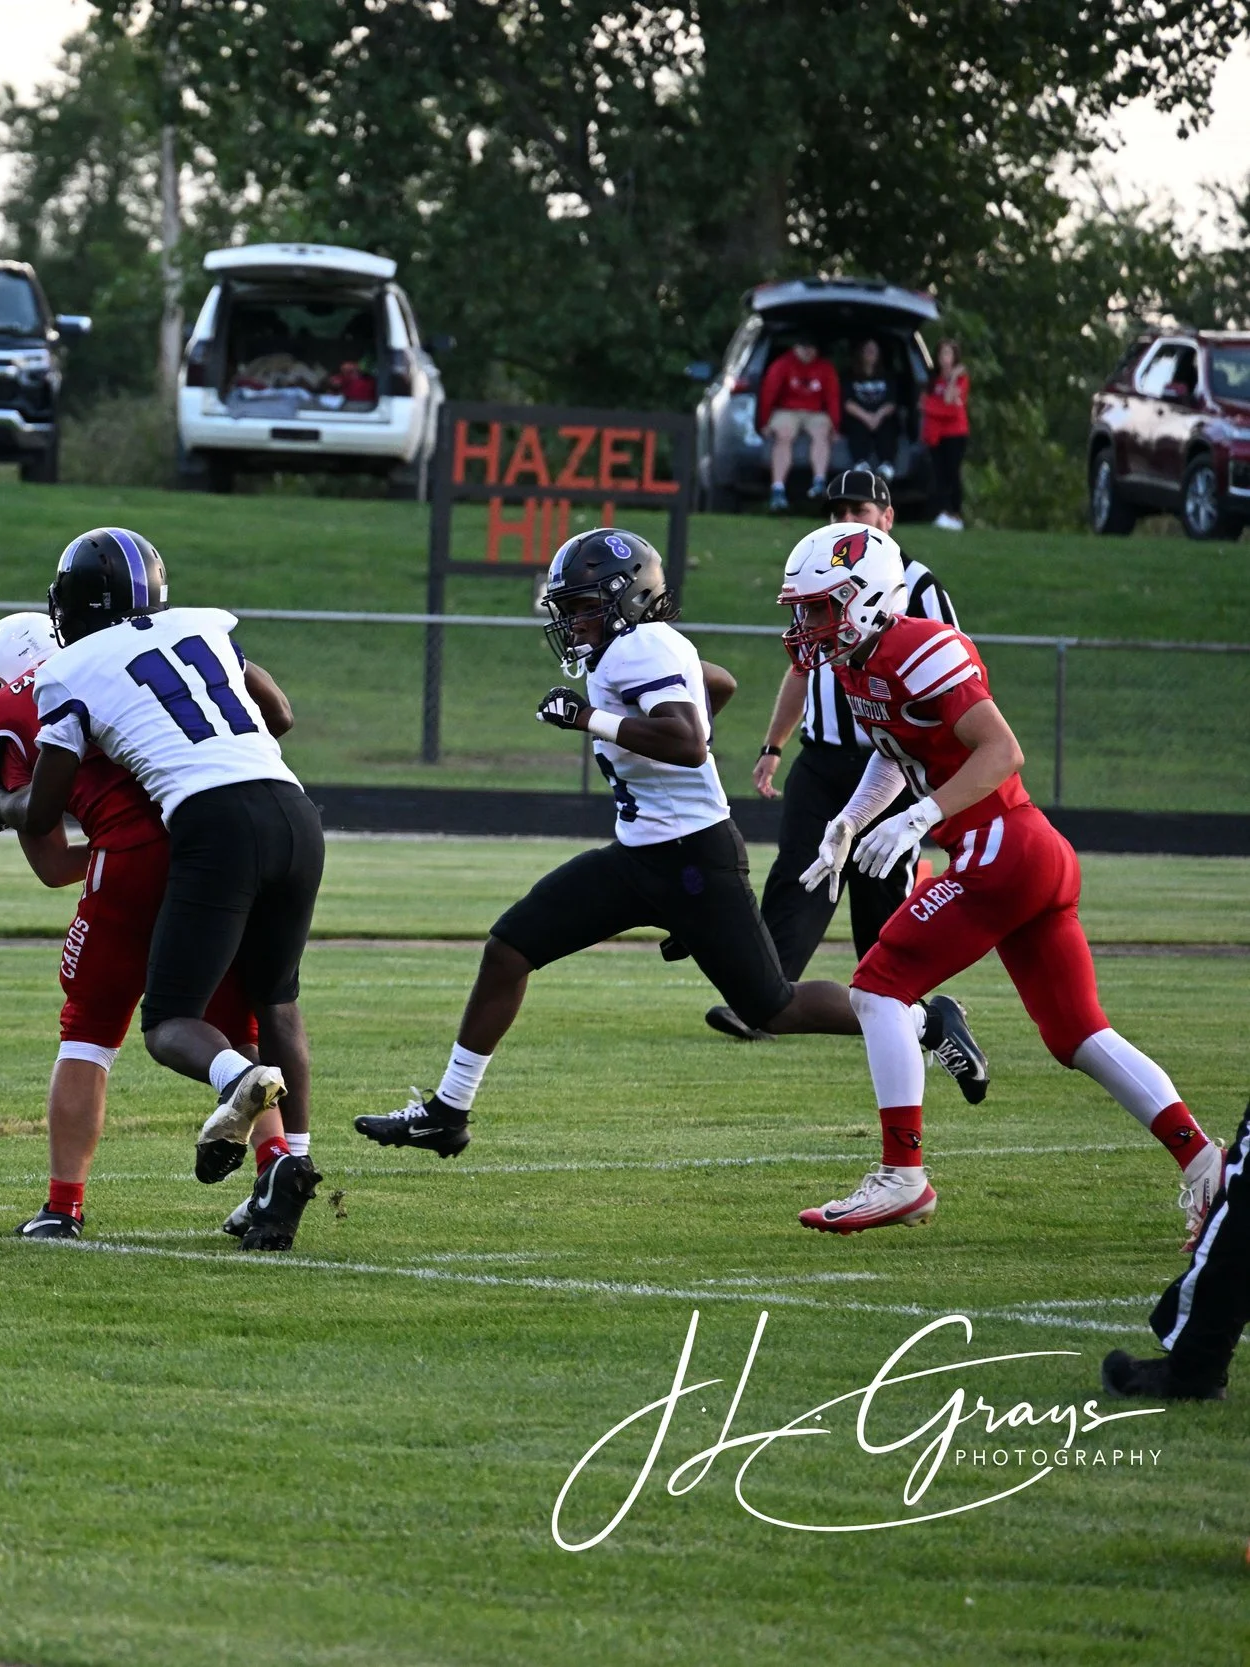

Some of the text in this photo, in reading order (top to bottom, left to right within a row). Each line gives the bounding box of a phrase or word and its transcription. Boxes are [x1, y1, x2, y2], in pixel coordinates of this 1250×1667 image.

[453, 420, 681, 493] HAZEL
[604, 535, 632, 559] 8
[124, 634, 260, 745] 11
[909, 879, 965, 922] CARDS
[60, 915, 90, 979] CARDS
